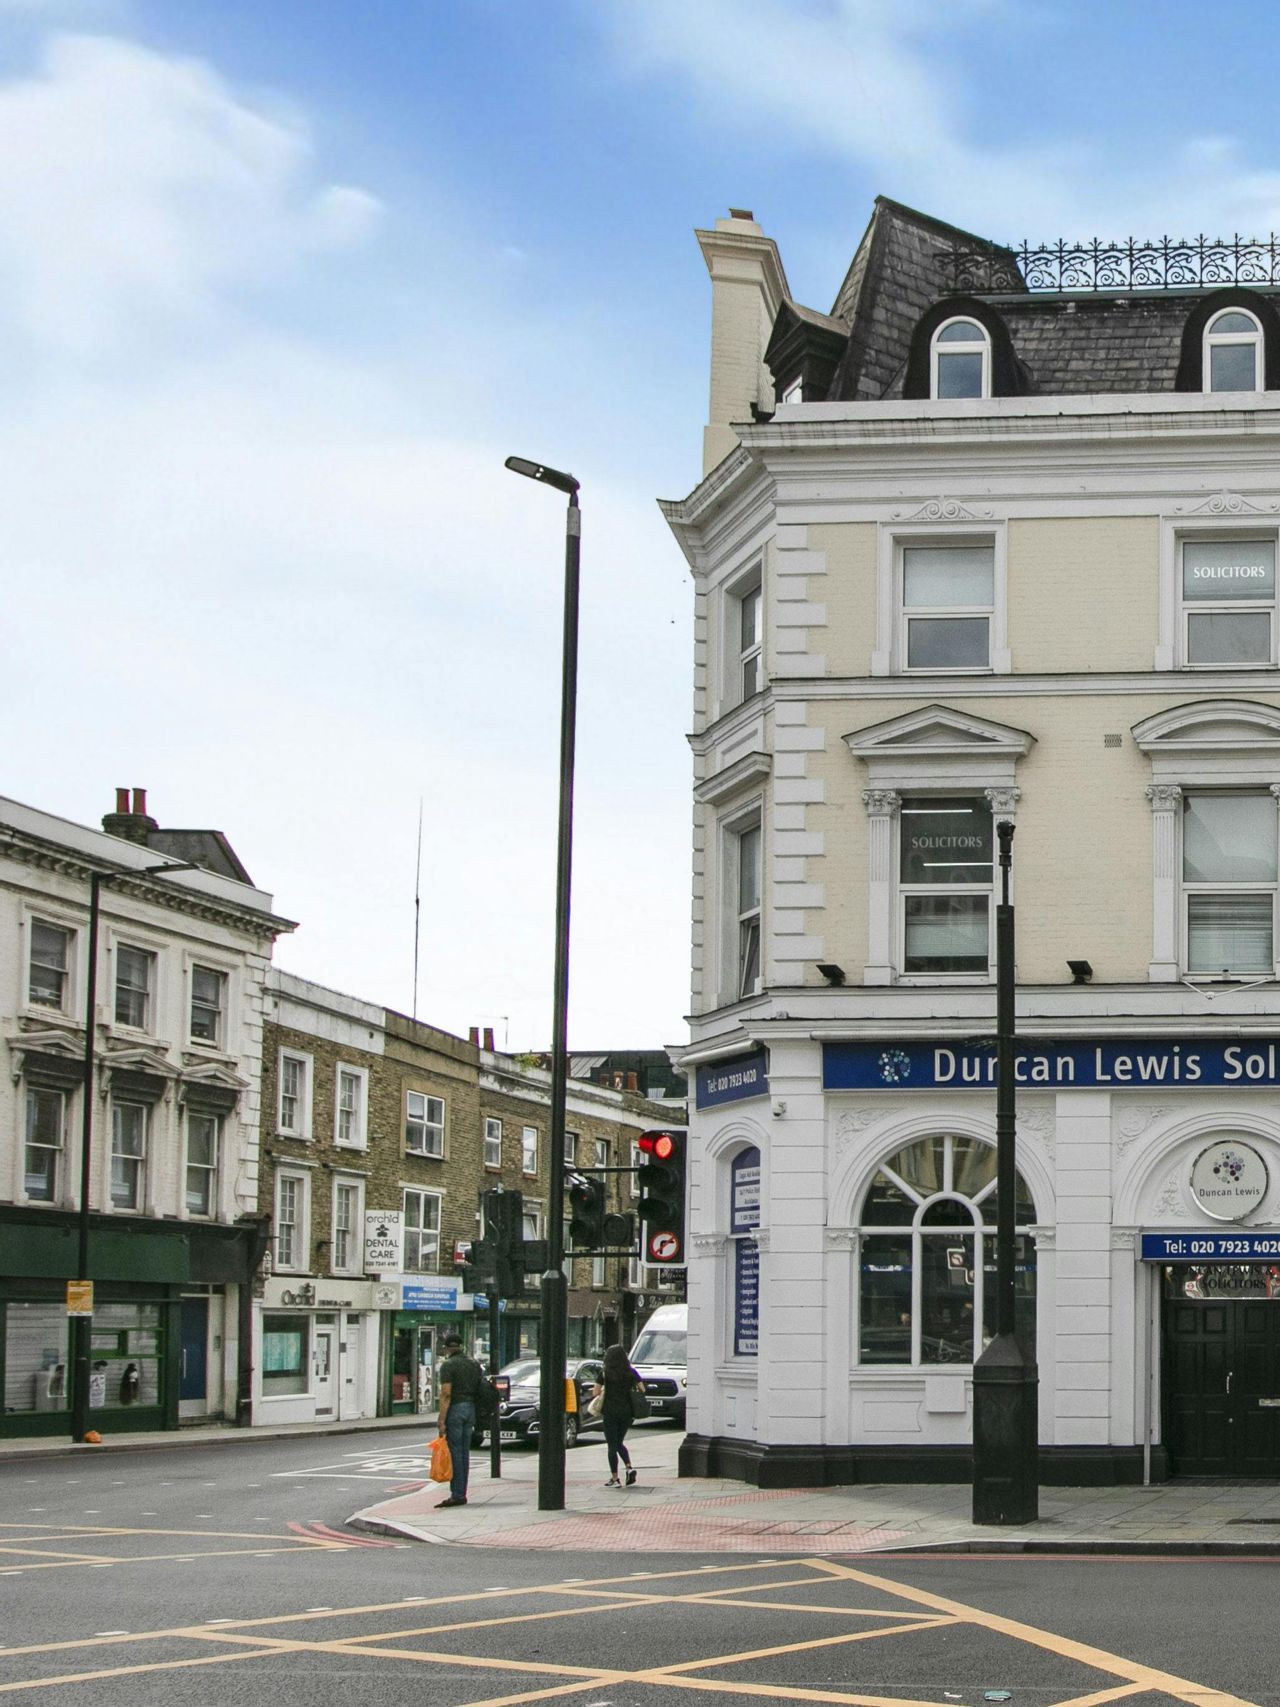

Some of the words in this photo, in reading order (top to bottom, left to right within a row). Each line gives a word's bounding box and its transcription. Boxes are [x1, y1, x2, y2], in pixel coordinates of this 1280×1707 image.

[1193, 566, 1265, 578] SOLICITORS
[911, 836, 983, 848] SOLICITORS
[933, 1049, 1075, 1082] Duncan
[1095, 1046, 1201, 1081] Lewis
[717, 1076, 728, 1091] 020
[729, 1072, 743, 1088] 7923
[743, 1068, 757, 1084] 4020
[1199, 1188, 1232, 1197] Duncan
[1235, 1186, 1260, 1196] Lewis
[366, 1239, 400, 1248] DENTAL
[1163, 1239, 1187, 1254] Tel:
[1190, 1240, 1215, 1254] 020
[1218, 1240, 1250, 1254] 7923
[369, 1250, 395, 1259] CARE
